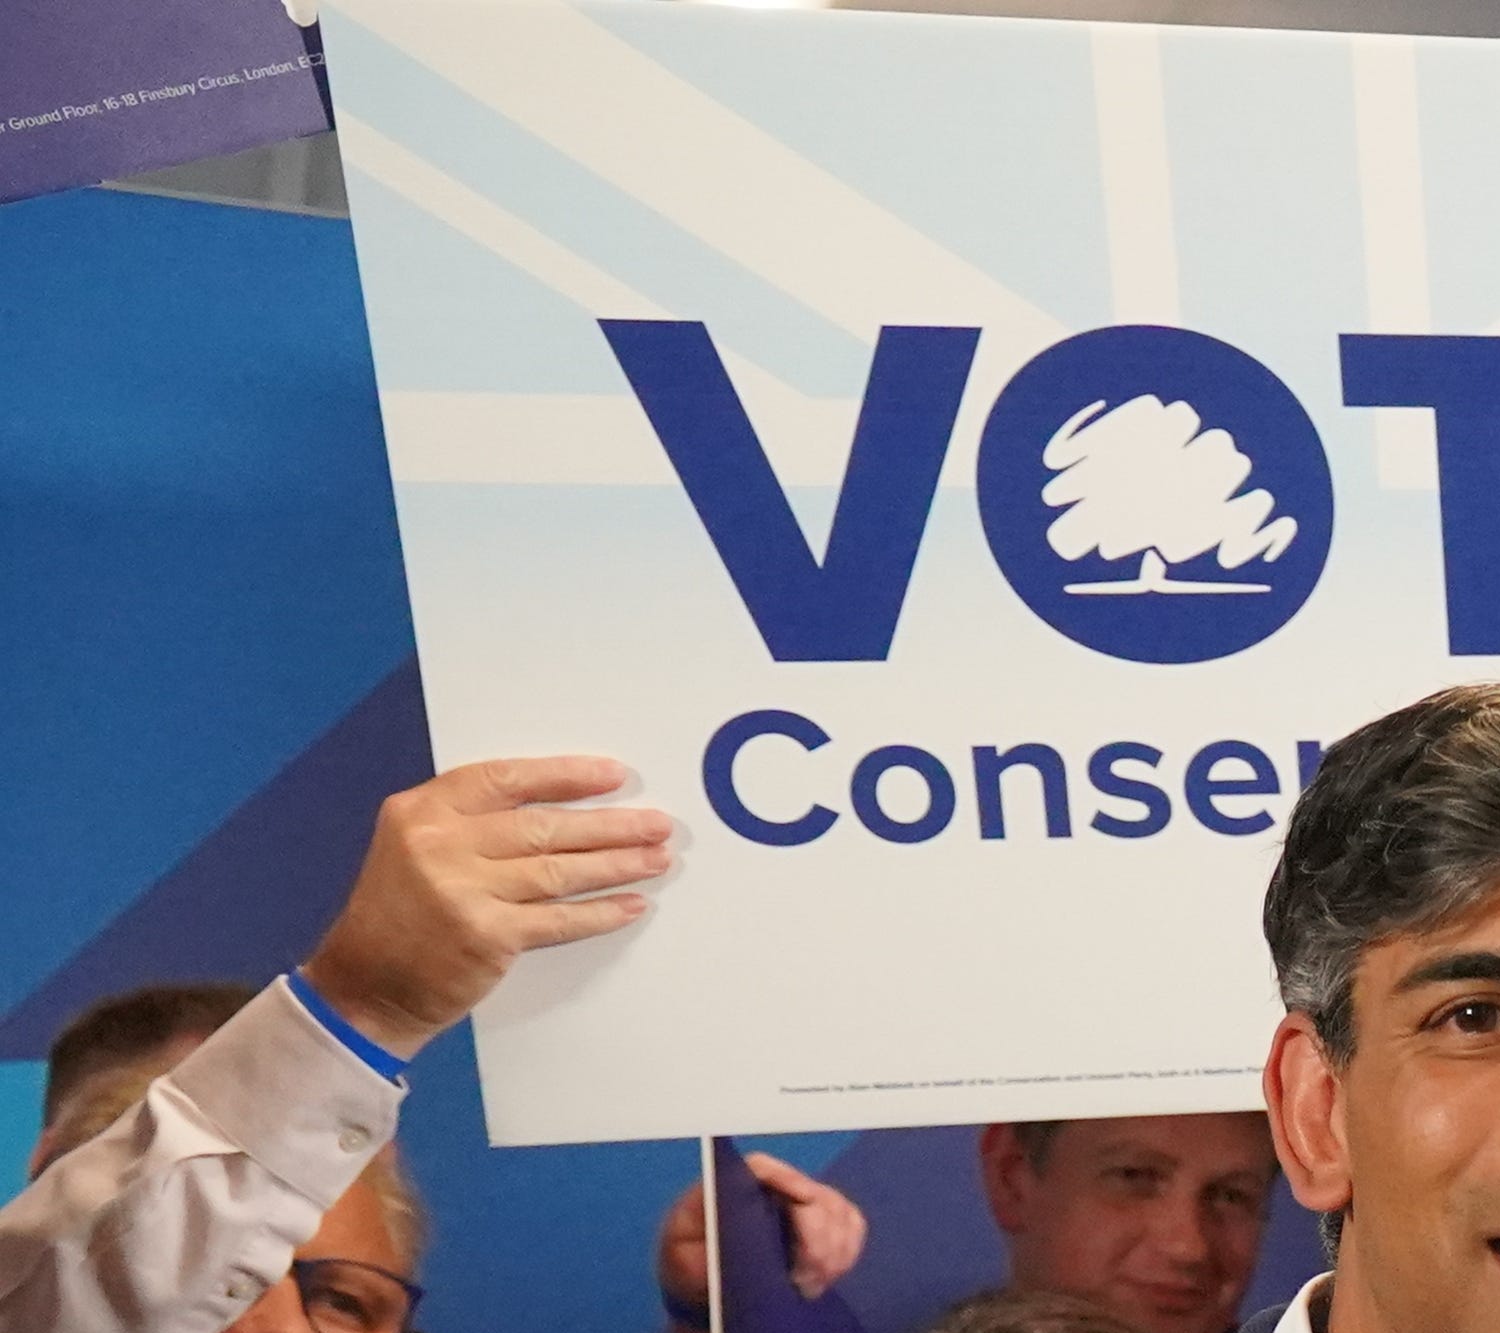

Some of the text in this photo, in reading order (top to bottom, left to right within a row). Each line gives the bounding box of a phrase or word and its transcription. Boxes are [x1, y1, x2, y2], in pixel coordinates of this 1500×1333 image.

[9, 109, 62, 131] Ground
[62, 102, 101, 119] Floor,
[102, 92, 138, 112] 16-18
[139, 81, 196, 105] Finsbury
